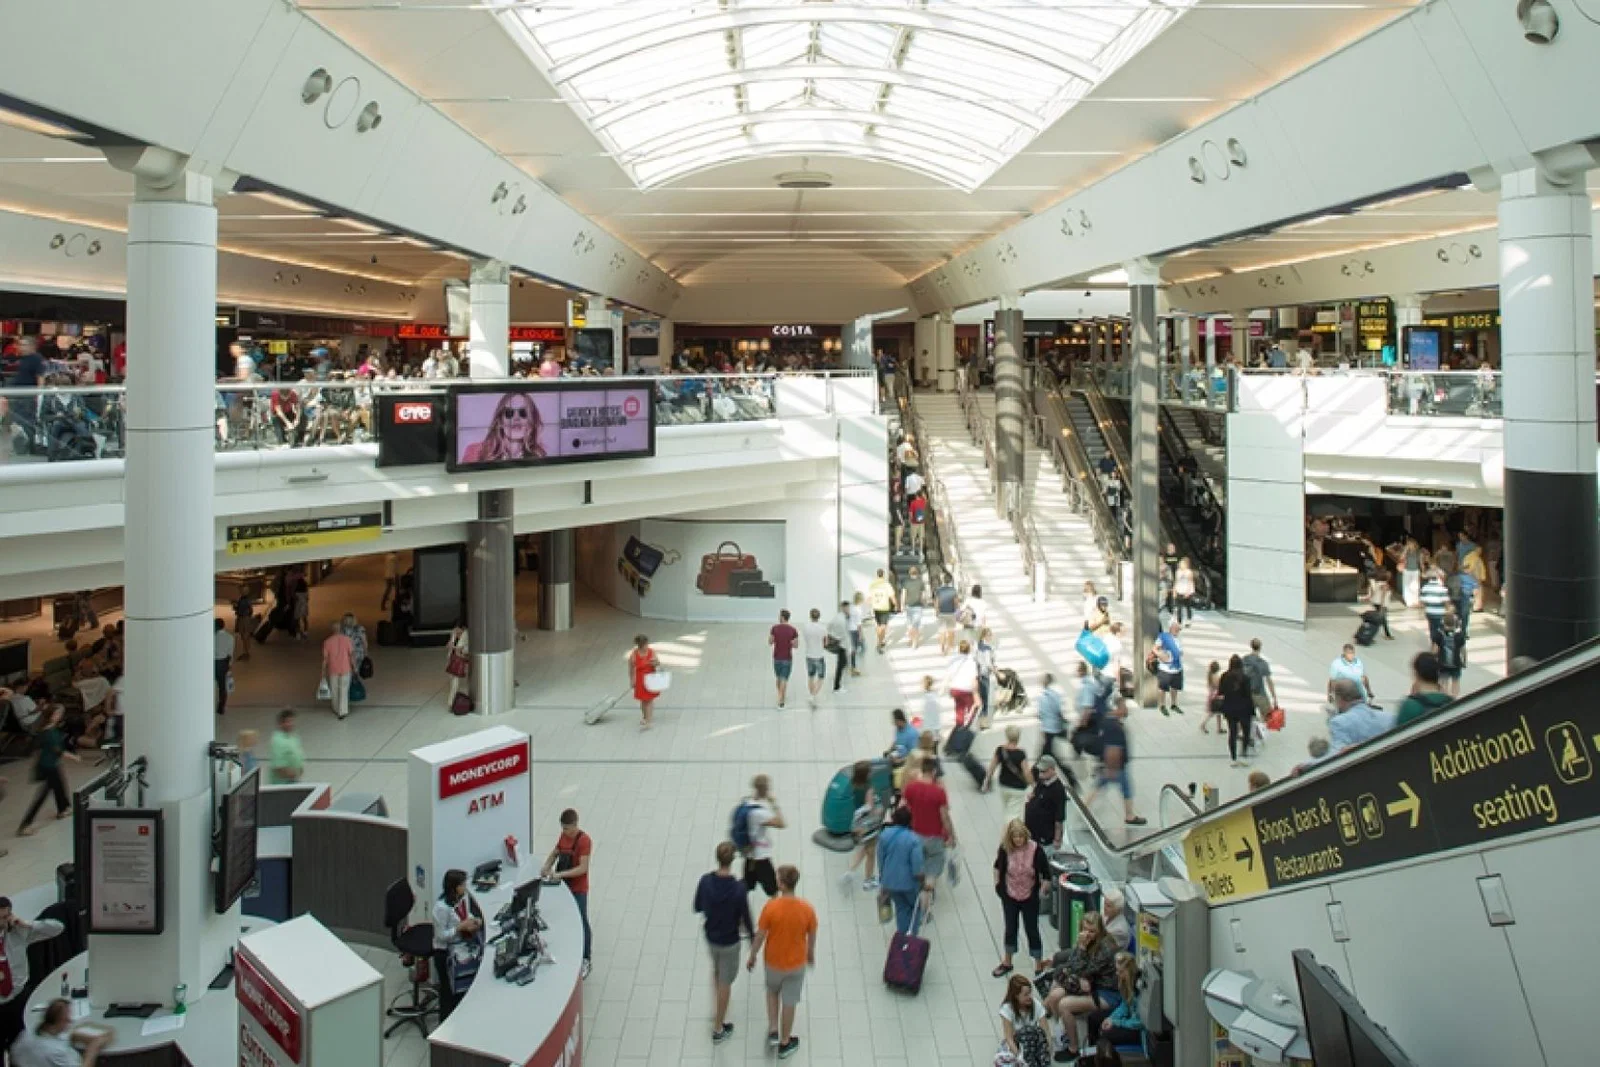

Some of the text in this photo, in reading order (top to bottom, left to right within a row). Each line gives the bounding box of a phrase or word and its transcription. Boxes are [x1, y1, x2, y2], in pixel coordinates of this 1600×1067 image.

[772, 326, 813, 336] COSTA
[1453, 314, 1491, 328] BRIDGE
[1429, 715, 1536, 784] Additional
[450, 755, 520, 785] MONEYCORP
[468, 791, 504, 815] ATM
[1473, 784, 1558, 829] seating
[1258, 797, 1332, 845] Shops, bars &
[1274, 845, 1344, 881] Restaurants
[1201, 874, 1235, 898] Toilets
